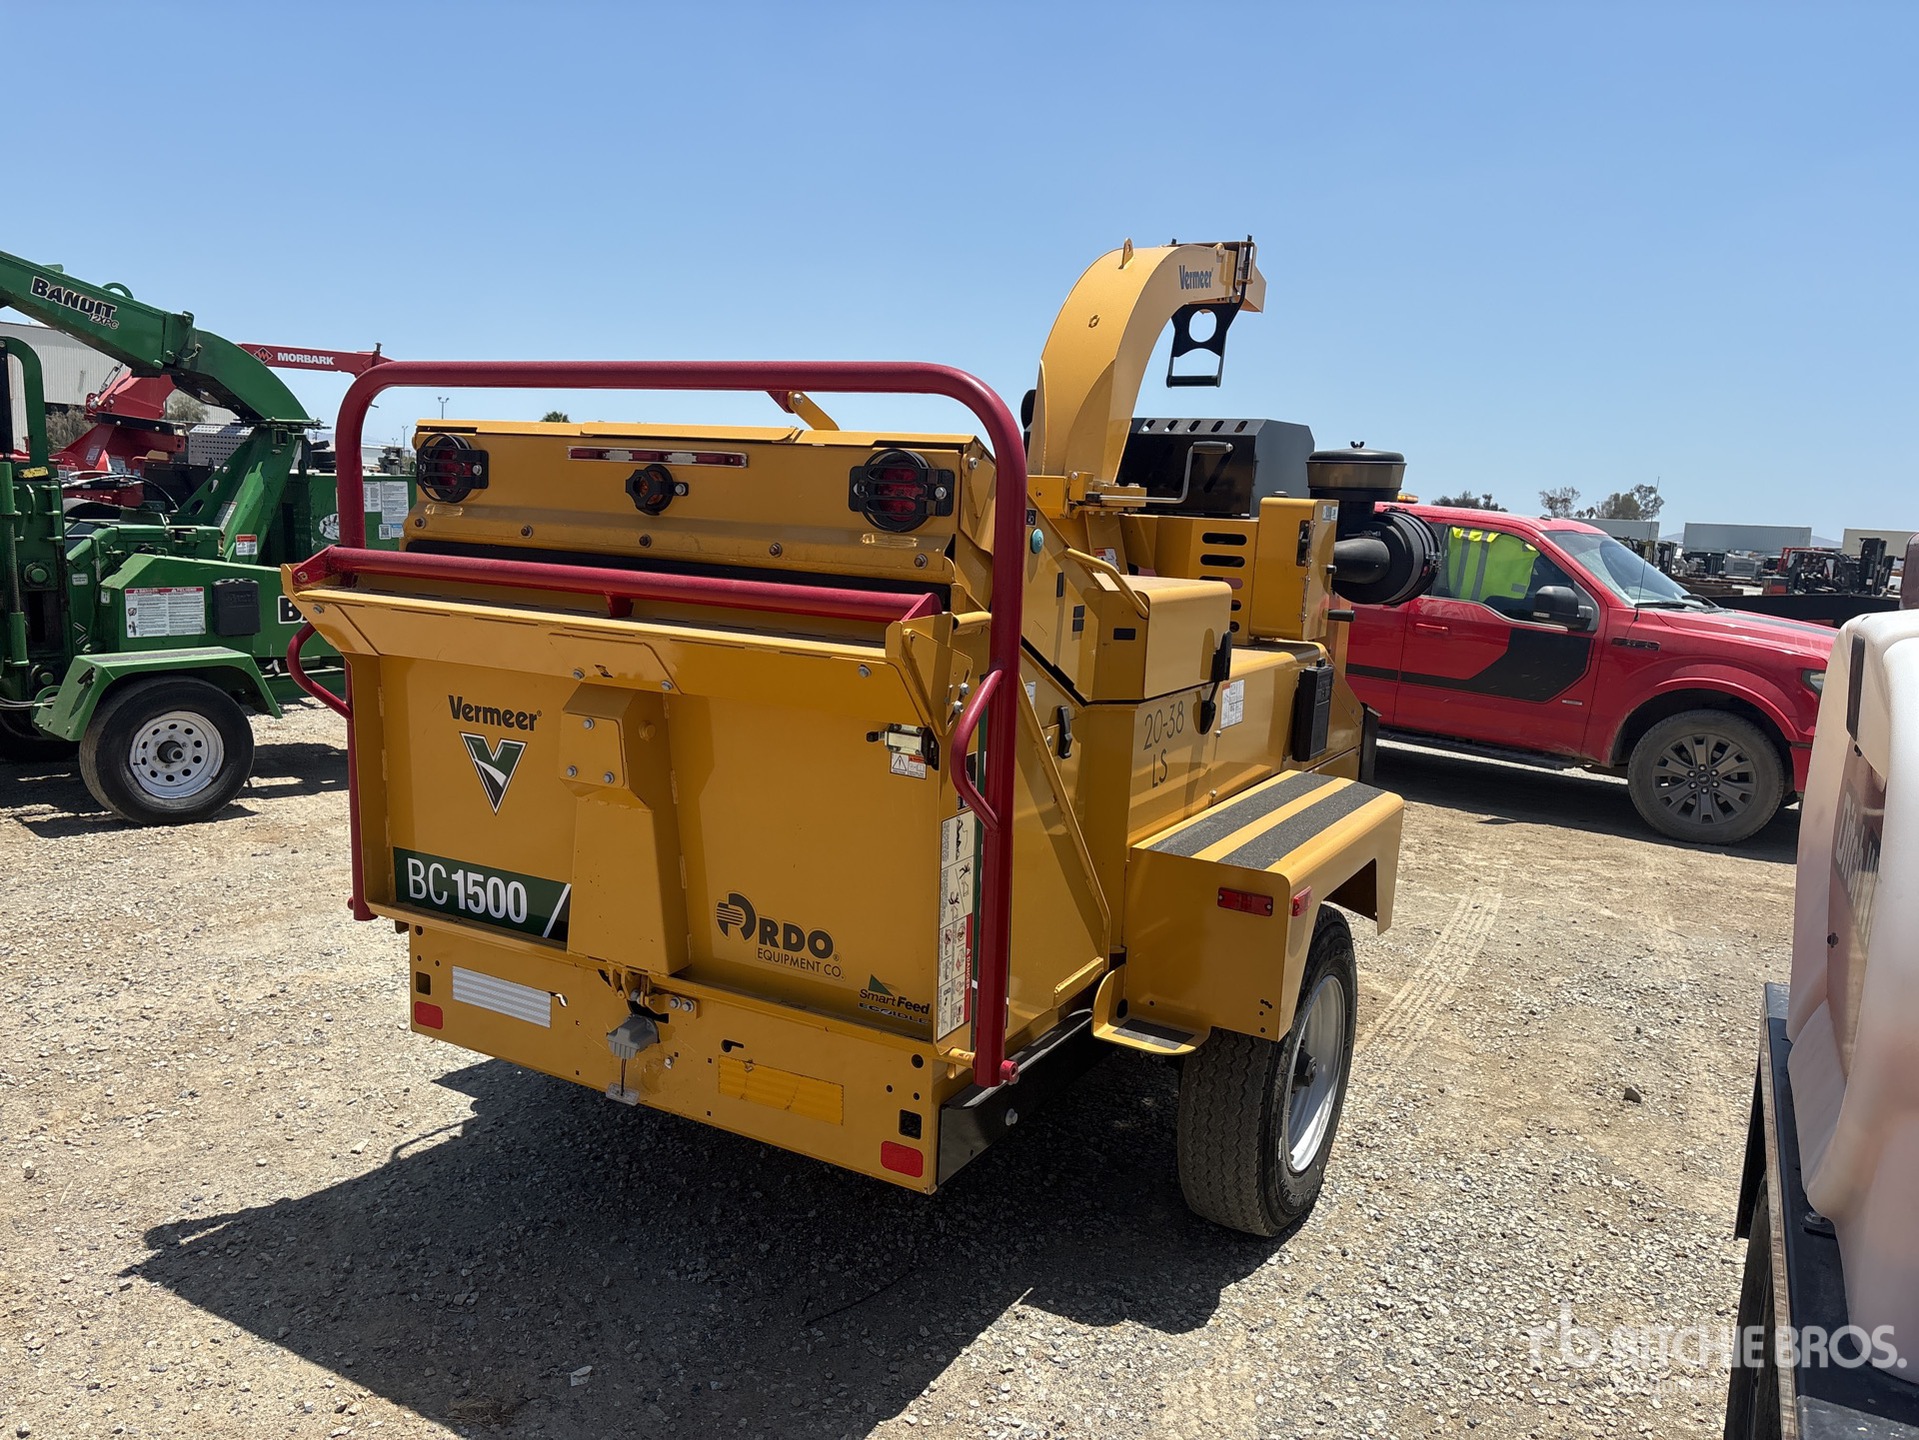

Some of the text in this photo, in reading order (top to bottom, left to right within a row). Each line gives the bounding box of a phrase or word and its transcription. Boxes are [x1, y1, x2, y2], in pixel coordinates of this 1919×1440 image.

[1178, 264, 1213, 290] Vermeer
[29, 275, 118, 319] BANDIT
[88, 312, 120, 330] 12XPC
[277, 352, 335, 366] MORBARK
[448, 694, 538, 732] Vermeer
[1143, 700, 1185, 751] 20-38
[1152, 748, 1168, 789] LS
[758, 917, 834, 960] RDO
[757, 947, 845, 980] EQUIPMENT CO.
